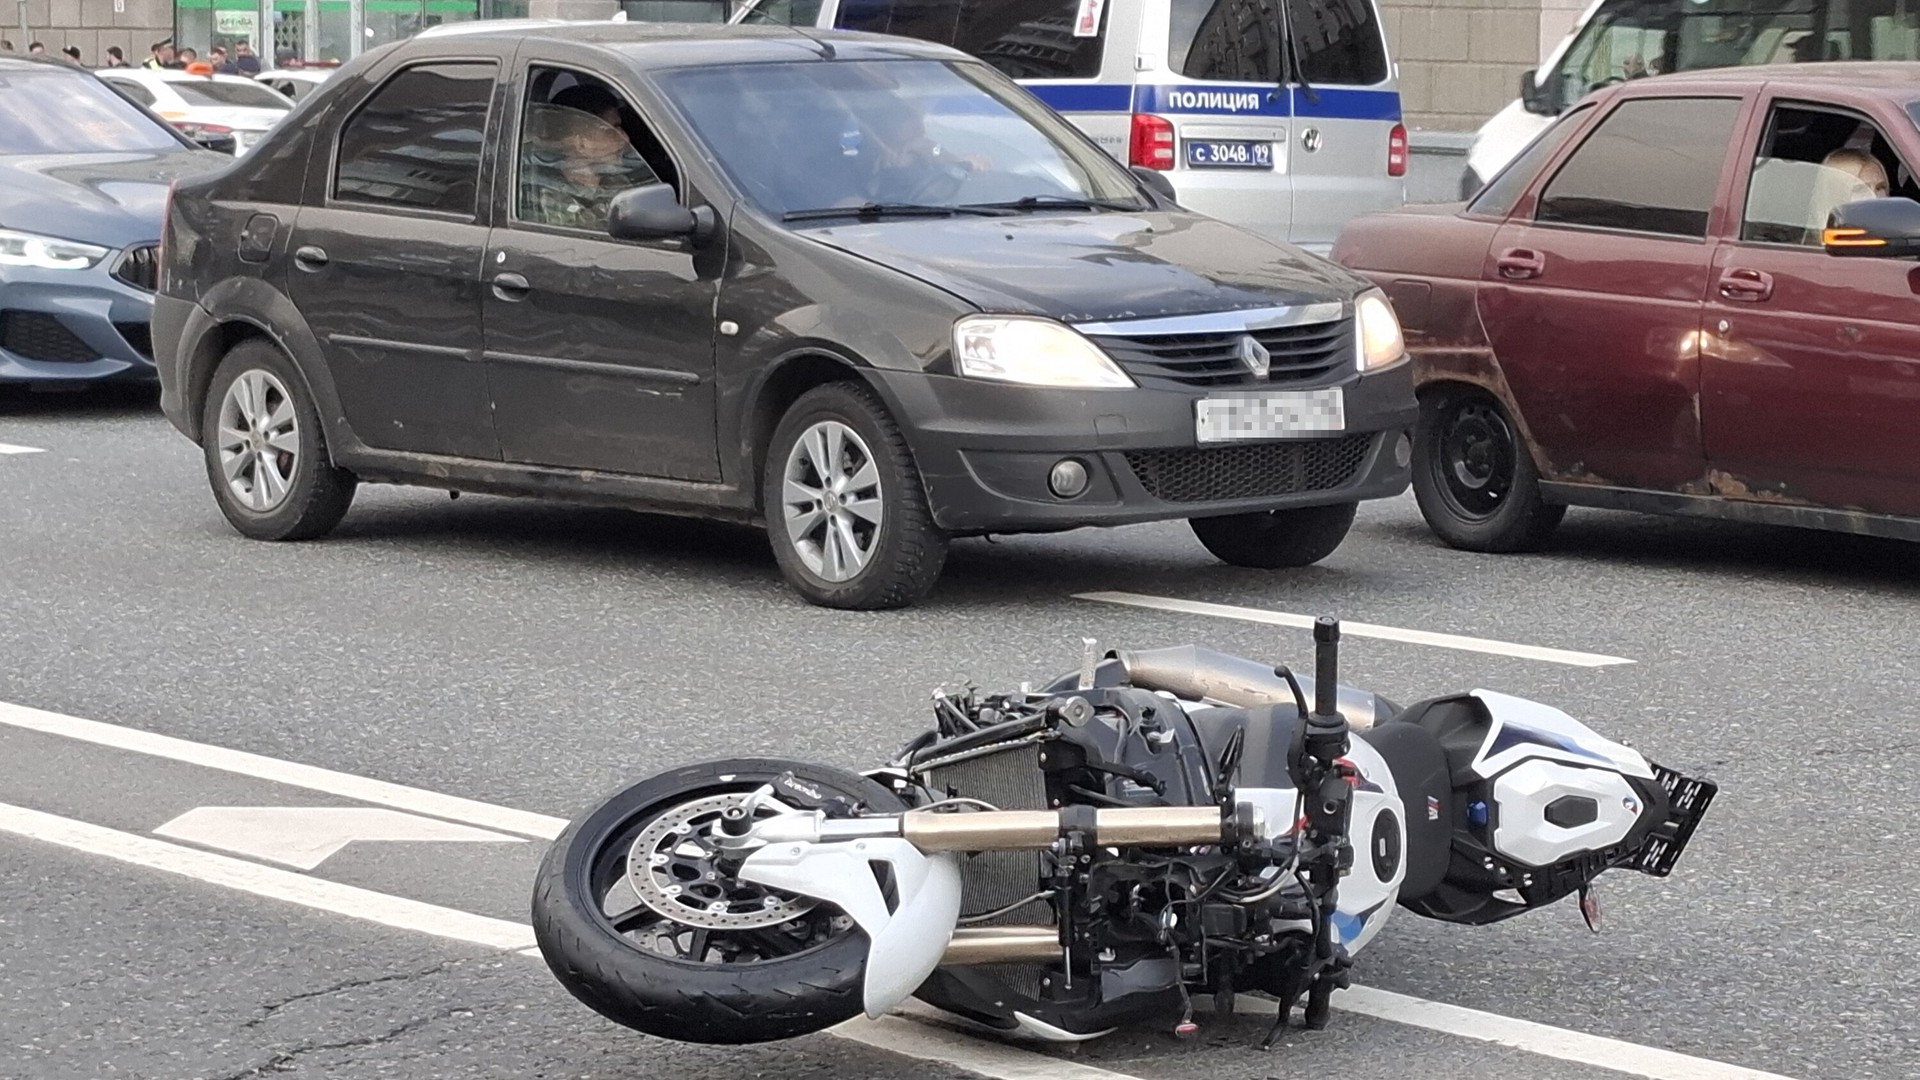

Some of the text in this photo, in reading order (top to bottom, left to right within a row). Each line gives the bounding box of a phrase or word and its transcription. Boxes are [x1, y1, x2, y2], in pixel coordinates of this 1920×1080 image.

[1169, 92, 1259, 112] ПОЛИЦИЯ
[1210, 144, 1247, 162] 3048
[1254, 143, 1269, 160] 99
